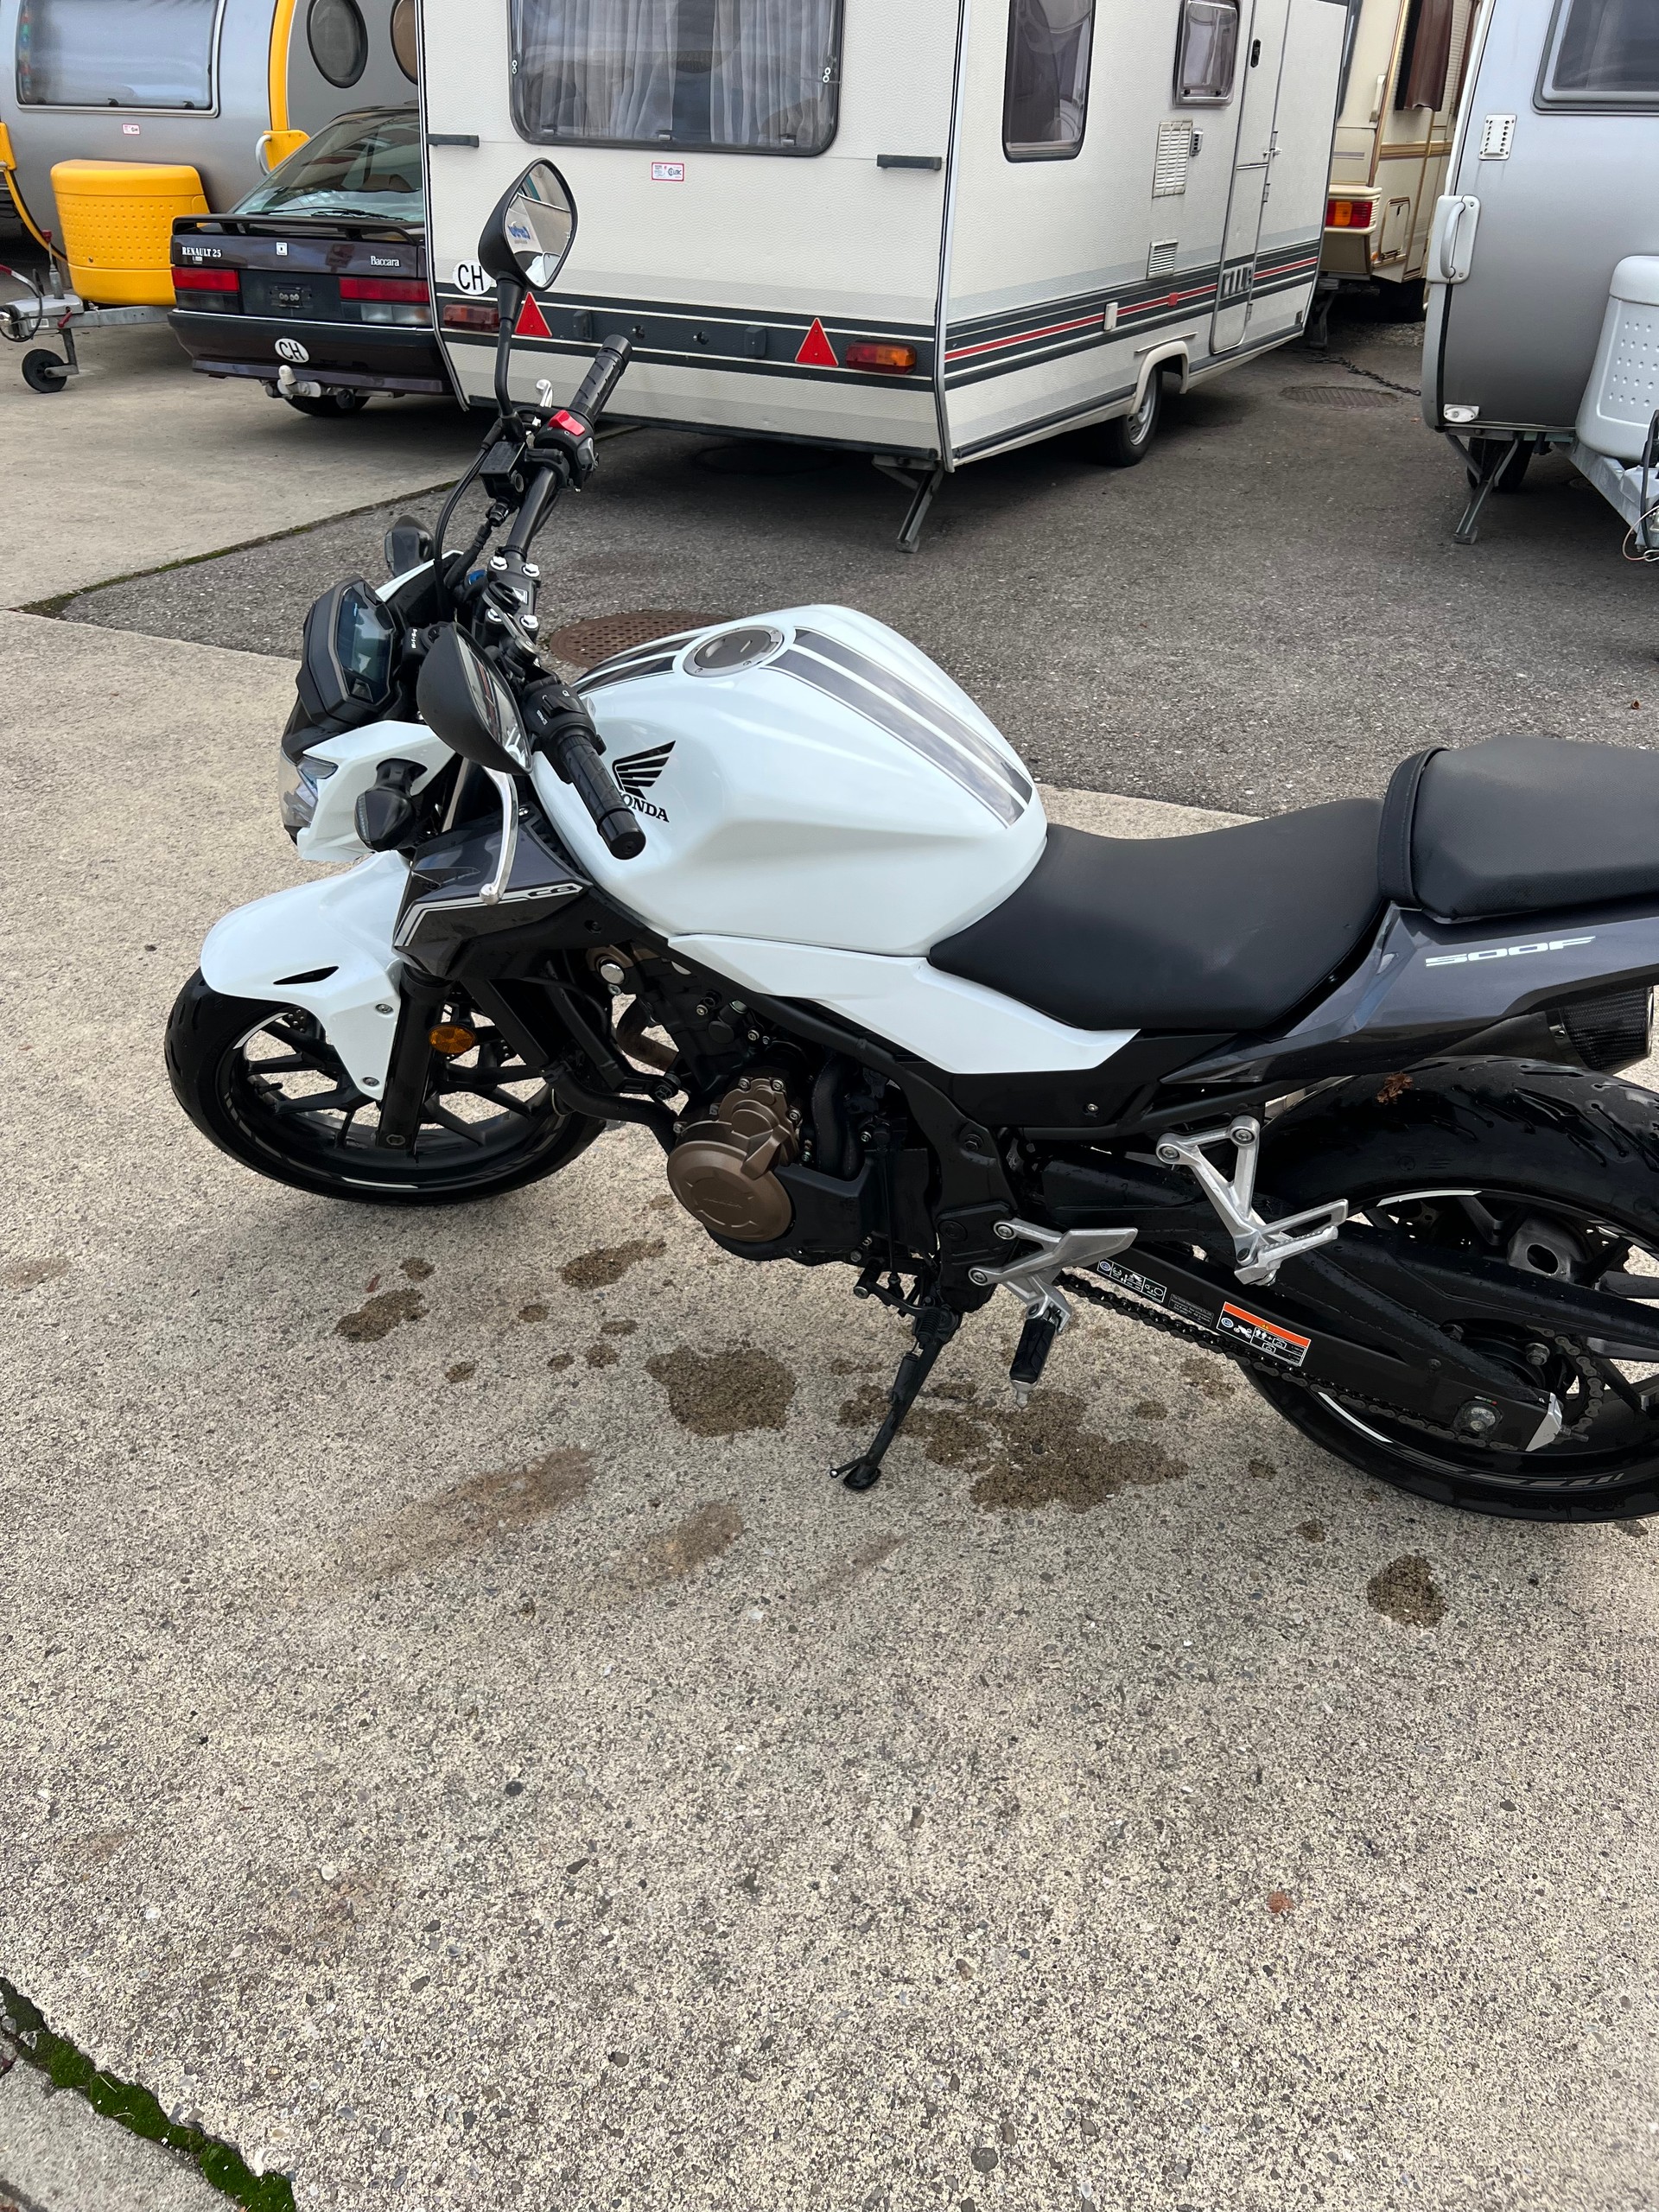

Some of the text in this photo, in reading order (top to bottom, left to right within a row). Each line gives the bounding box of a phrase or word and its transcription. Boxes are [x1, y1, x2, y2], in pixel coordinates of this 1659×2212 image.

[181, 246, 222, 258] RENAULT 25
[370, 255, 400, 267] Baccara
[458, 264, 485, 291] CH
[278, 340, 306, 361] CH
[620, 792, 671, 823] ONDA
[1425, 936, 1597, 967] 500F
